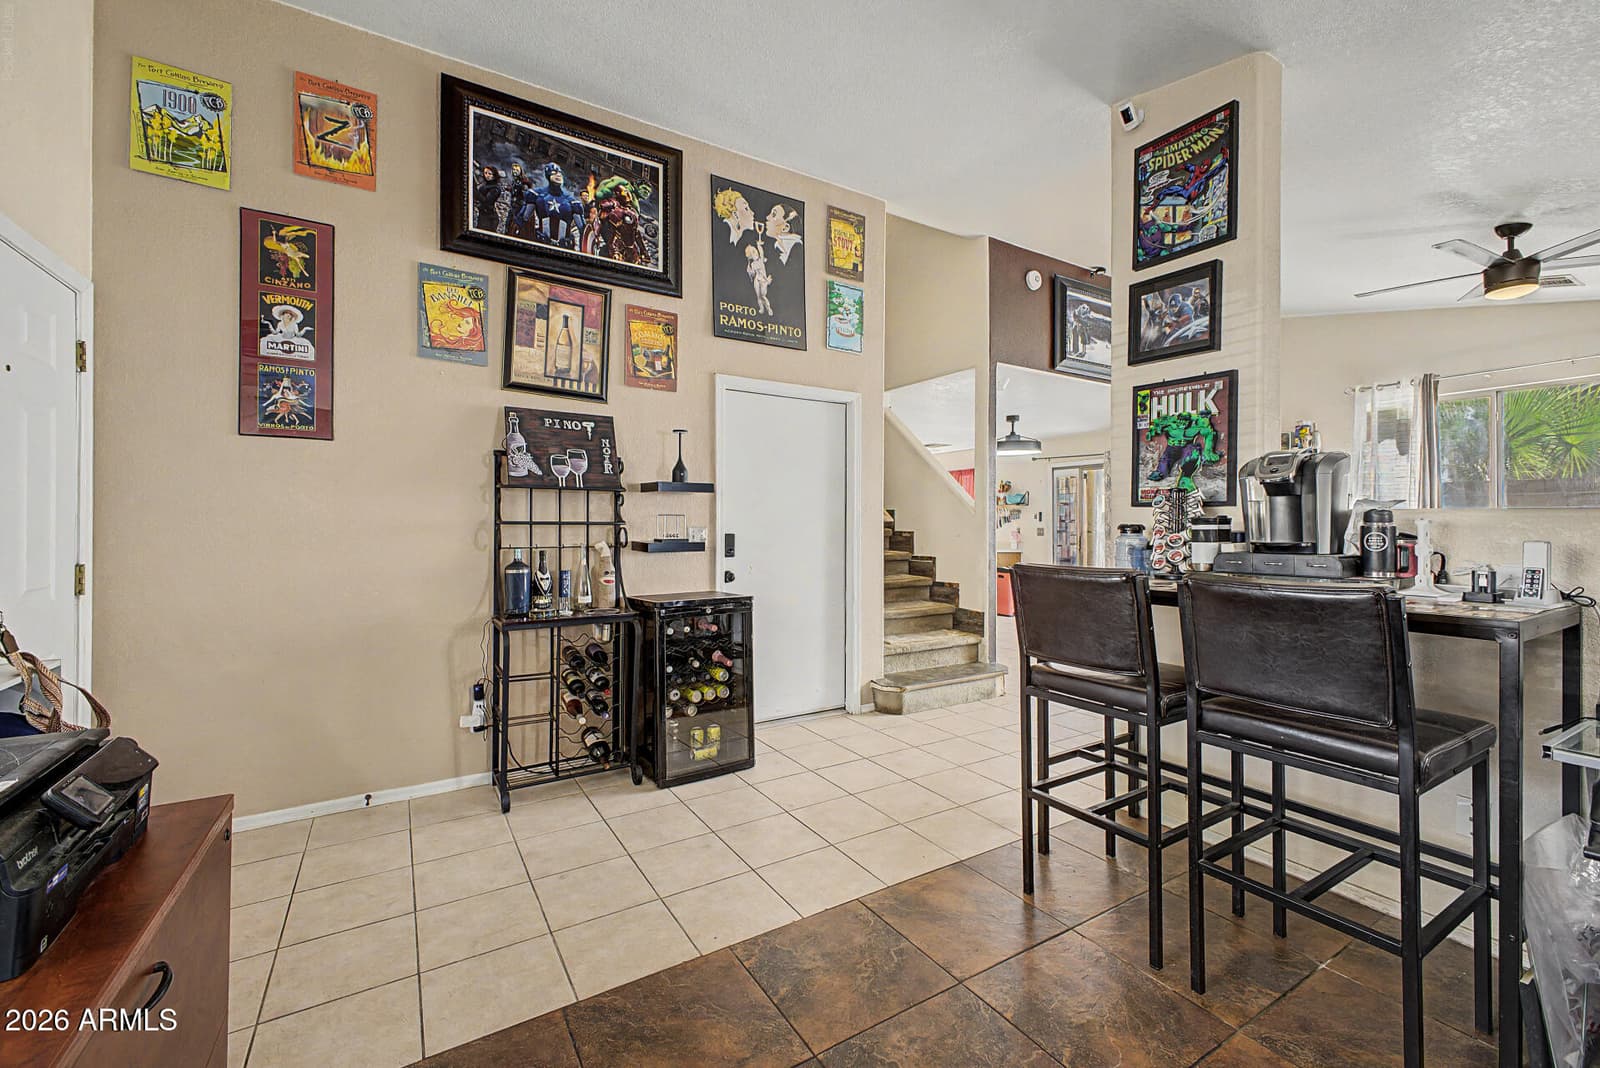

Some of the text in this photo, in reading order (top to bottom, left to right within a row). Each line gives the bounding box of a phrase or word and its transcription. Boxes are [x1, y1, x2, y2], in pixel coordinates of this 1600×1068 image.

[162, 89, 197, 115] 1900
[1163, 127, 1209, 155] AMAZING
[264, 276, 311, 289] CINZANO
[262, 294, 314, 311] VERMOUTH
[720, 301, 757, 317] PORTO
[267, 341, 308, 353] MARTINI
[259, 364, 315, 377] RAMOS PINTO
[1150, 380, 1223, 422] HULK
[543, 417, 596, 440] PINOT
[601, 438, 614, 474] NOIR
[16, 845, 39, 870] brother
